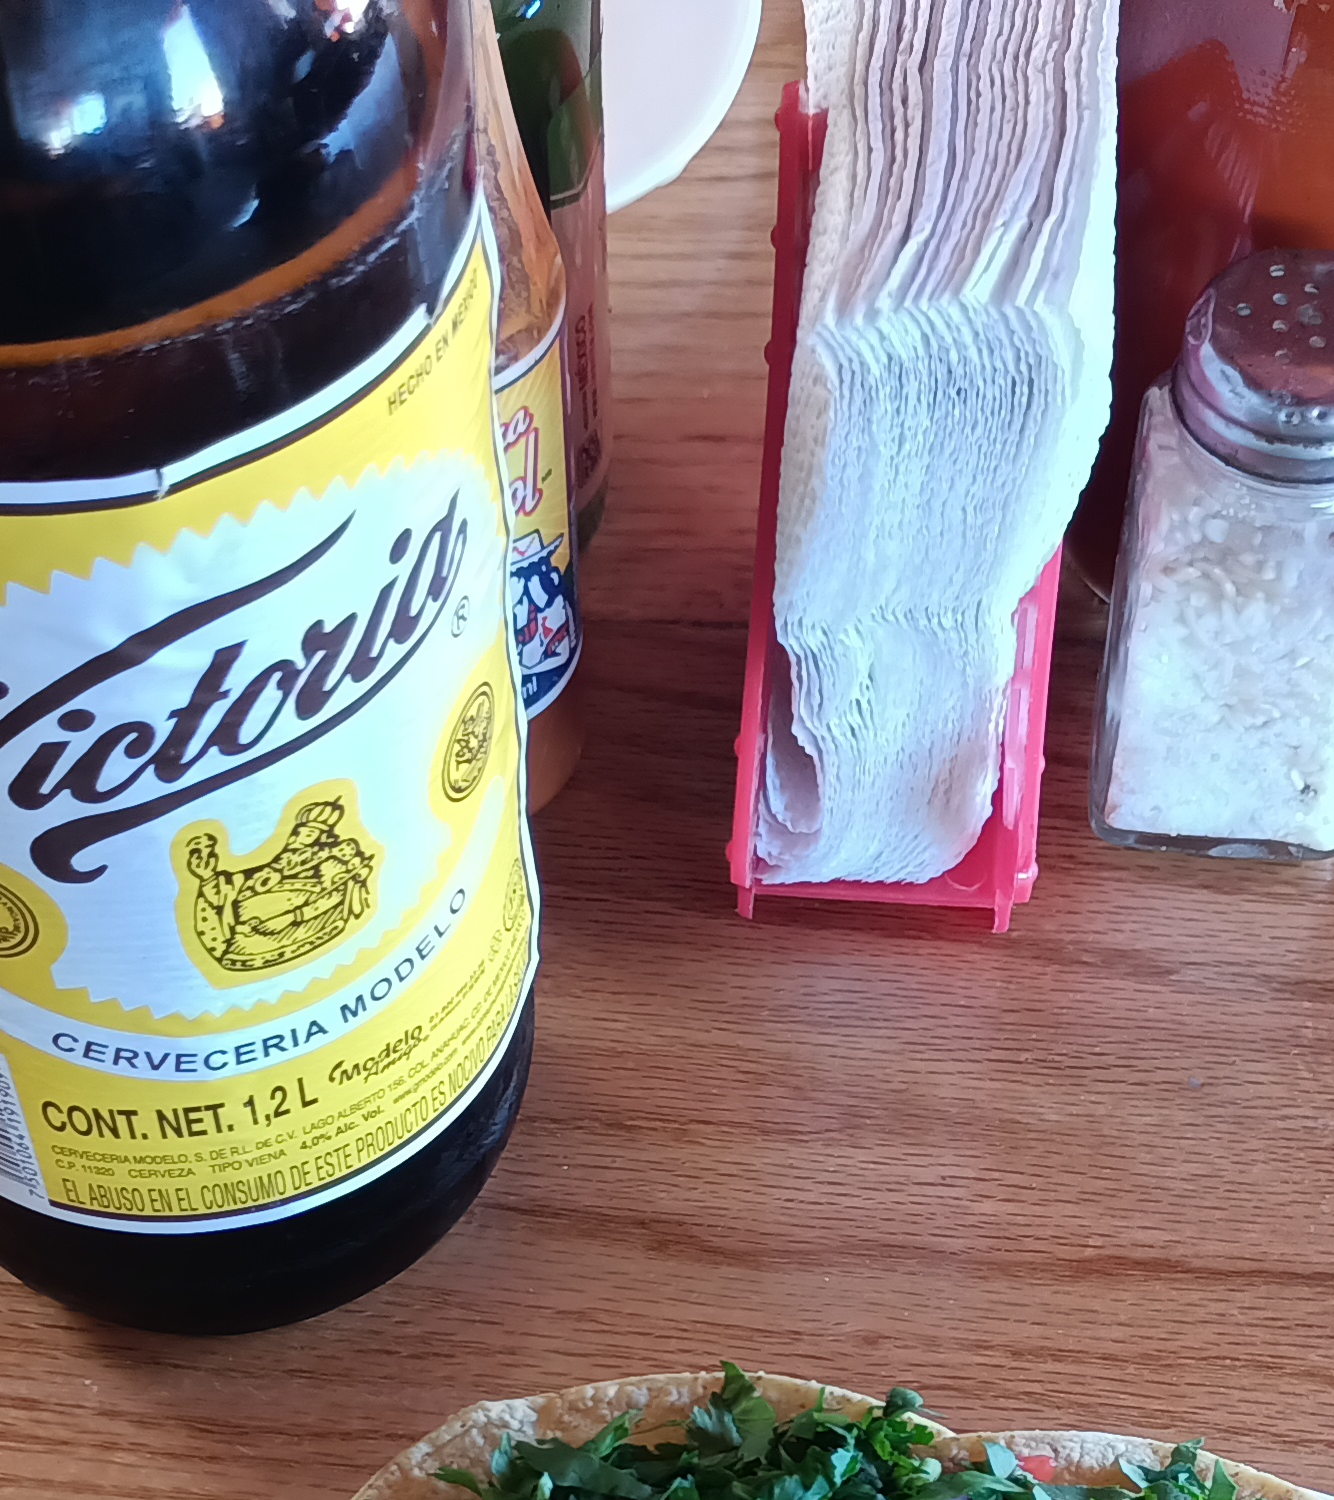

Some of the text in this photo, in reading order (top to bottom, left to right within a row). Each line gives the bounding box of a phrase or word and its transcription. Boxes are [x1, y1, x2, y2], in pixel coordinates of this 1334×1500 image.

[387, 354, 433, 416] HECHO
[435, 328, 449, 363] EN
[51, 1019, 329, 1073] CERVECERIA
[339, 887, 467, 1024] MODELO
[328, 1025, 423, 1086] Modelo
[41, 1076, 319, 1140] CONT. NET. 1,2 L
[51, 1144, 131, 1164] CERVECERIA
[209, 1148, 228, 1161] DE
[255, 1138, 273, 1150] DE
[302, 1115, 335, 1135] LAGO
[337, 1088, 385, 1121] ALBERTO
[62, 1177, 86, 1205] EL
[88, 1182, 145, 1213] ABUSO
[147, 1187, 173, 1213] EN
[174, 1187, 198, 1212] EL
[200, 1169, 287, 1210] CONSUMO
[289, 1160, 313, 1191] DE
[314, 1142, 353, 1182] ESTE
[355, 1095, 428, 1164] PRODUCTO
[431, 1080, 446, 1113] ES
[448, 1036, 485, 1098] NOCIVO
[128, 1167, 196, 1178] CERVEZA
[208, 1148, 287, 1173] TIPO VIENA
